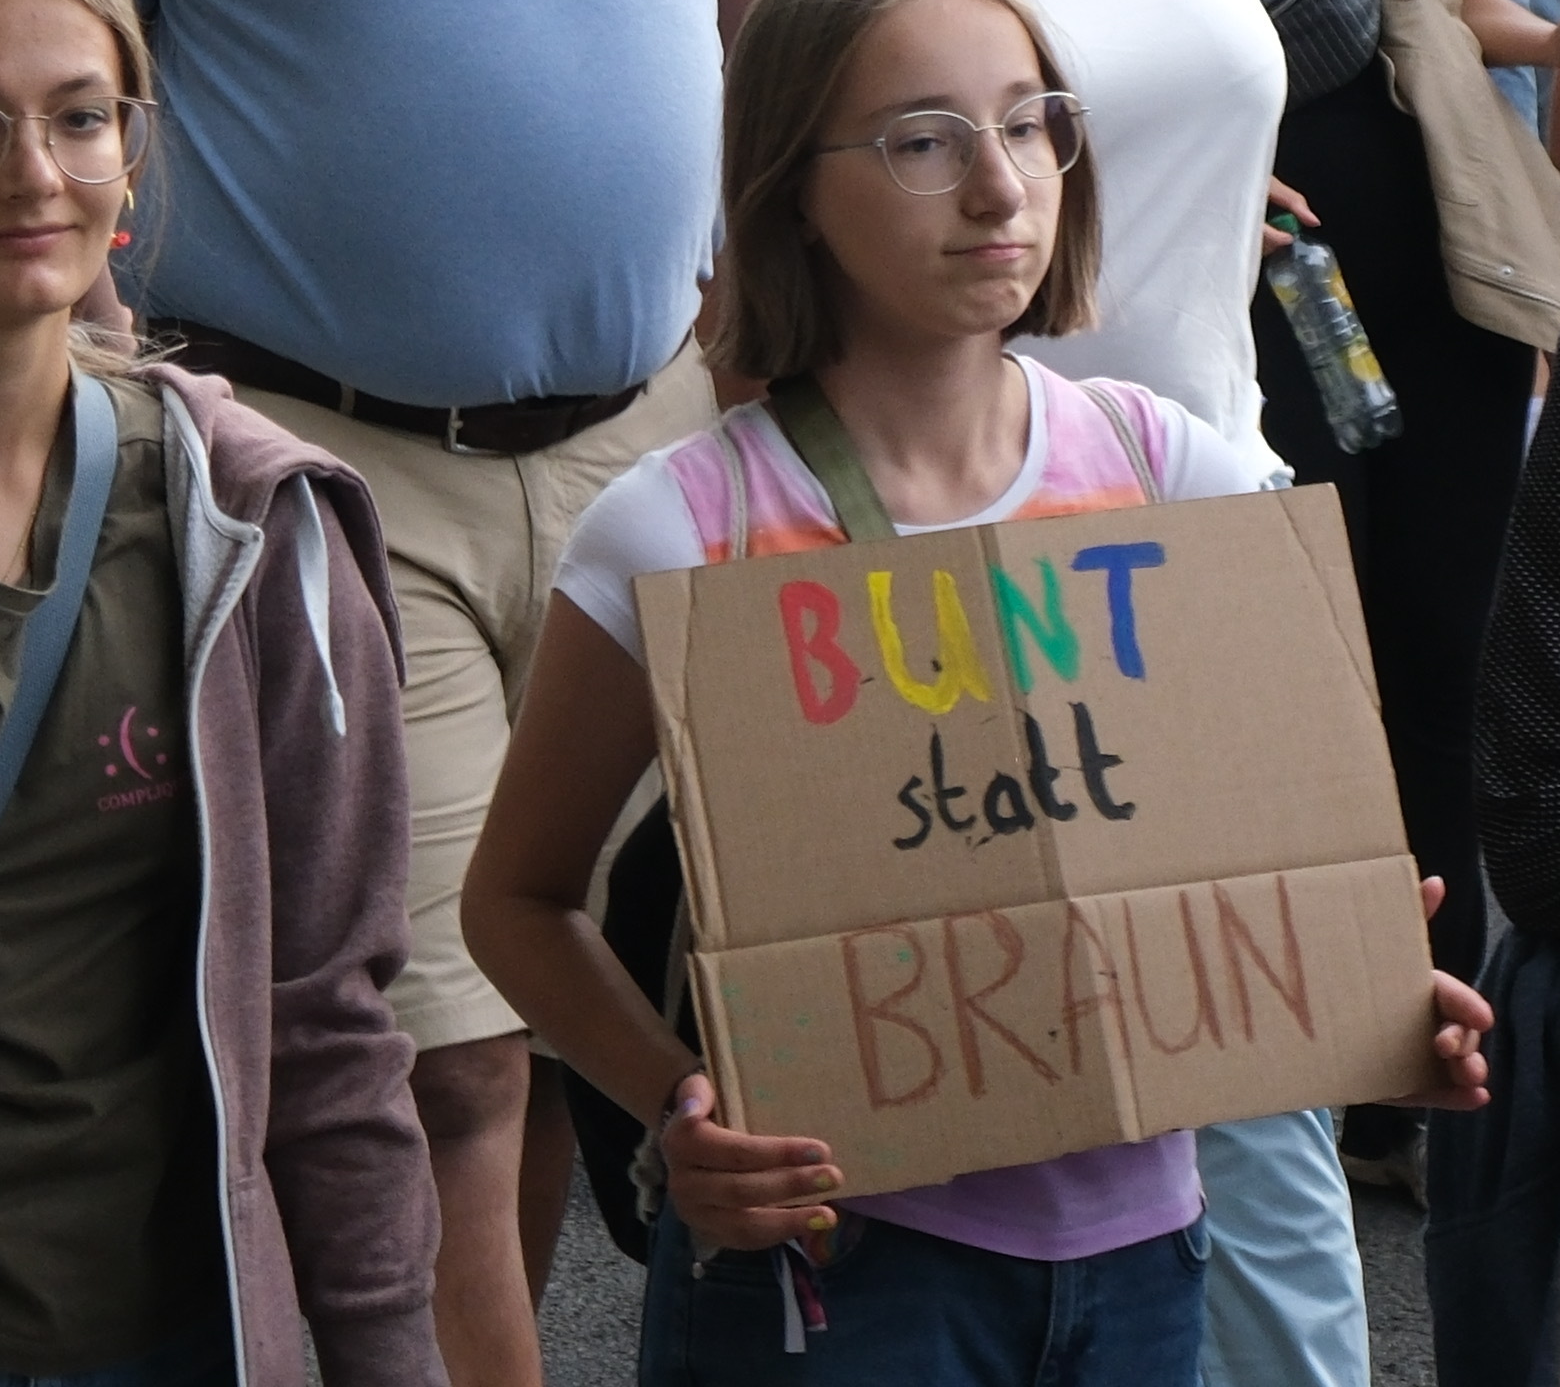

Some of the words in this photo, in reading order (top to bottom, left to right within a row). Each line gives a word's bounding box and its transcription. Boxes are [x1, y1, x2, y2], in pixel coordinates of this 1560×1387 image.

[778, 542, 1168, 726] BUNT
[892, 702, 1137, 851] statt
[840, 873, 1317, 1111] BRAUN
